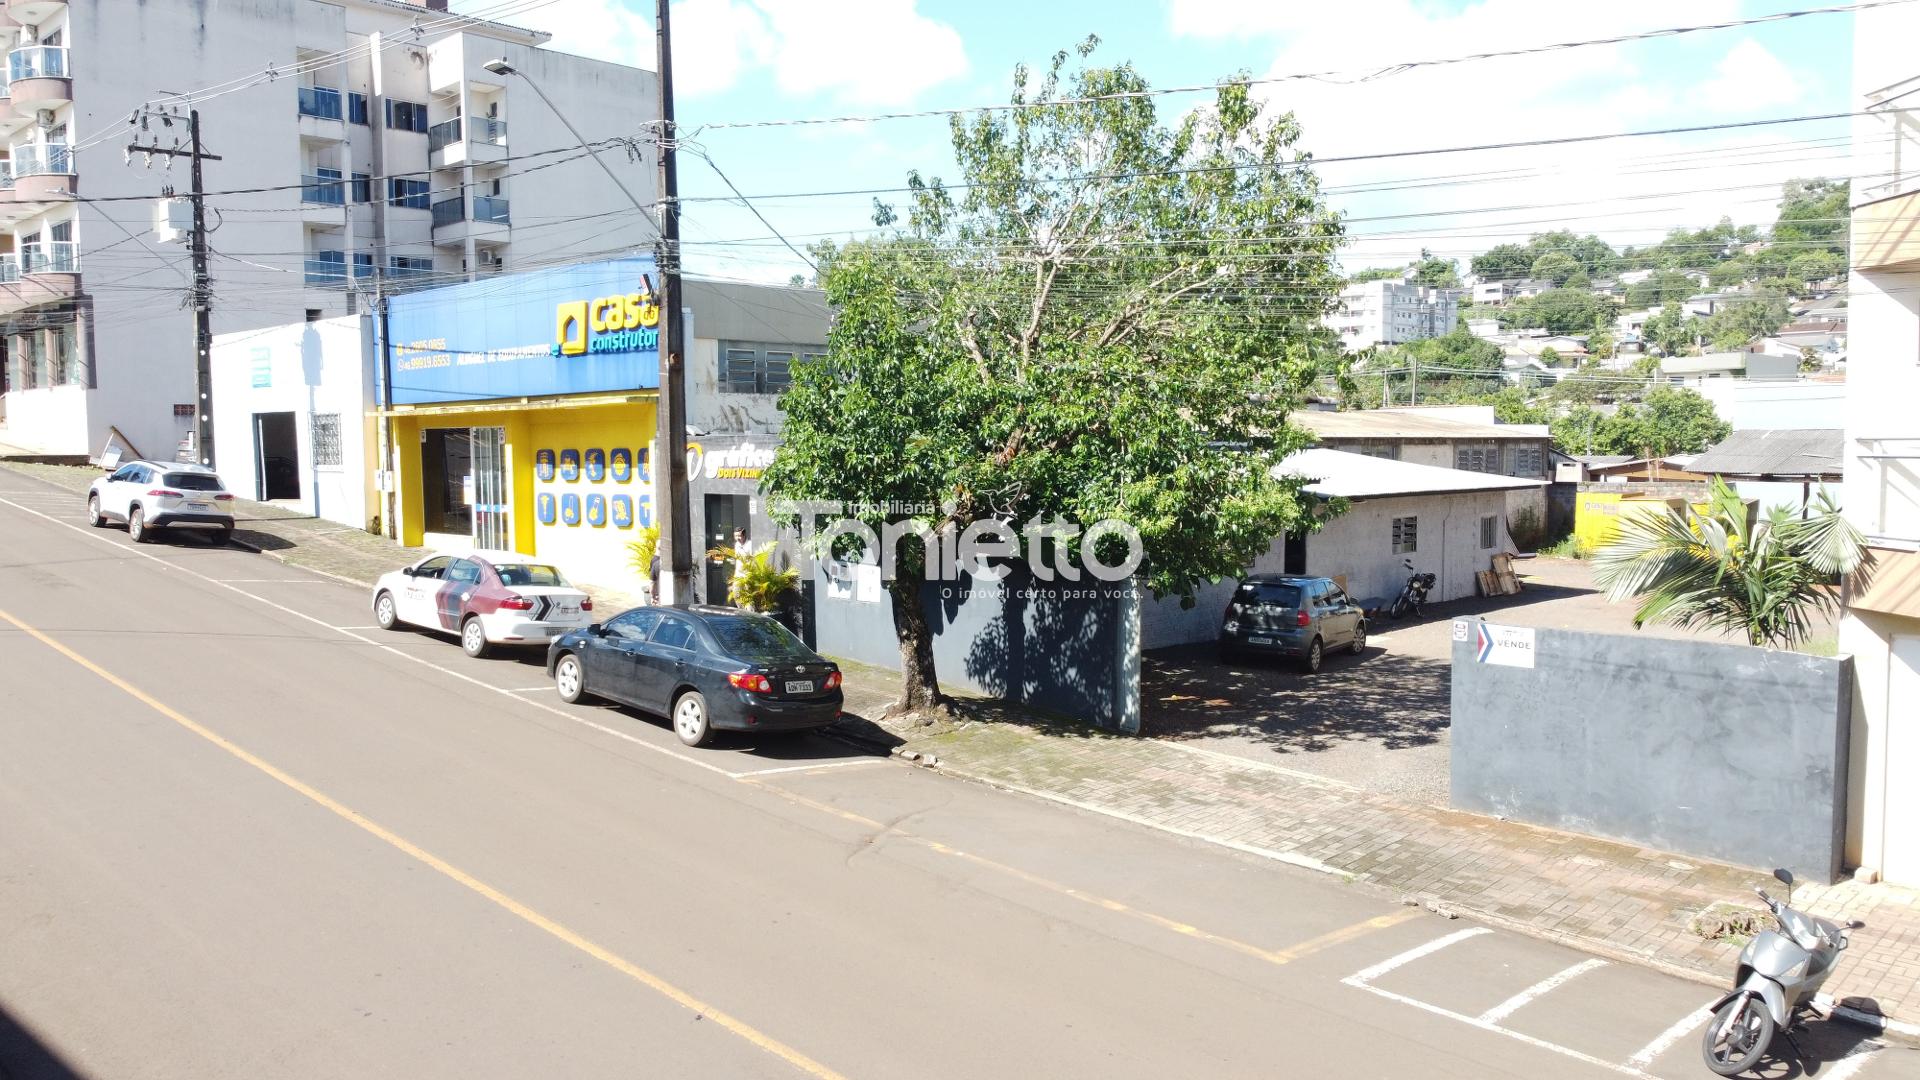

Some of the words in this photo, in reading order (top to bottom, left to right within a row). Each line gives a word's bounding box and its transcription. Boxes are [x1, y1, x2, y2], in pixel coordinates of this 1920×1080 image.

[589, 293, 660, 332] casa
[591, 328, 659, 351] construtor
[1497, 639, 1531, 650] VENDE
